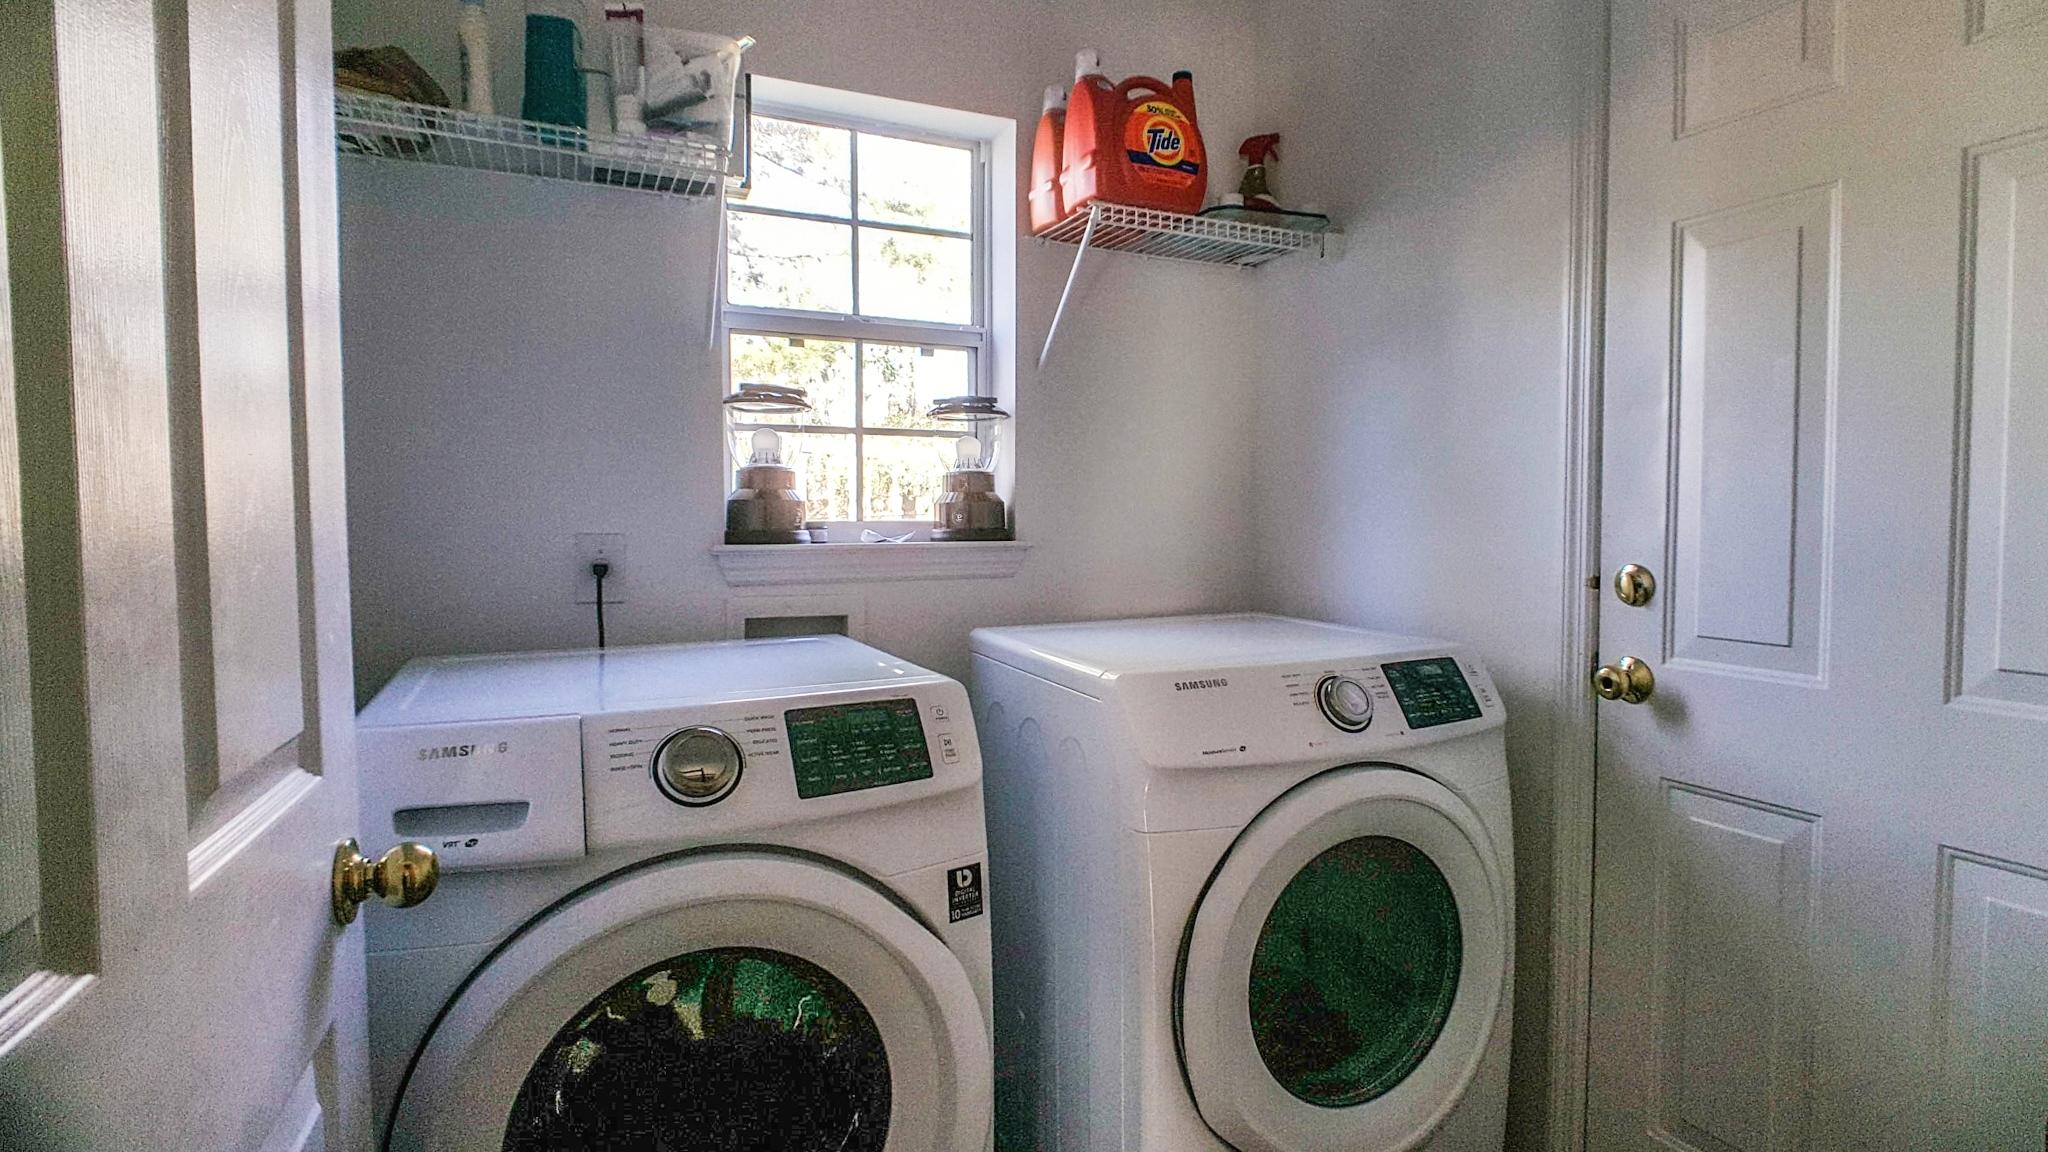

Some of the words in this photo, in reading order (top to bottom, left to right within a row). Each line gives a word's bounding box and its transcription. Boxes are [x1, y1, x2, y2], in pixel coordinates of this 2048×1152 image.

[1147, 128, 1181, 154] Tide
[1174, 678, 1228, 691] SAMSUNG
[418, 742, 508, 760] SAMSG
[951, 909, 961, 920] 10
